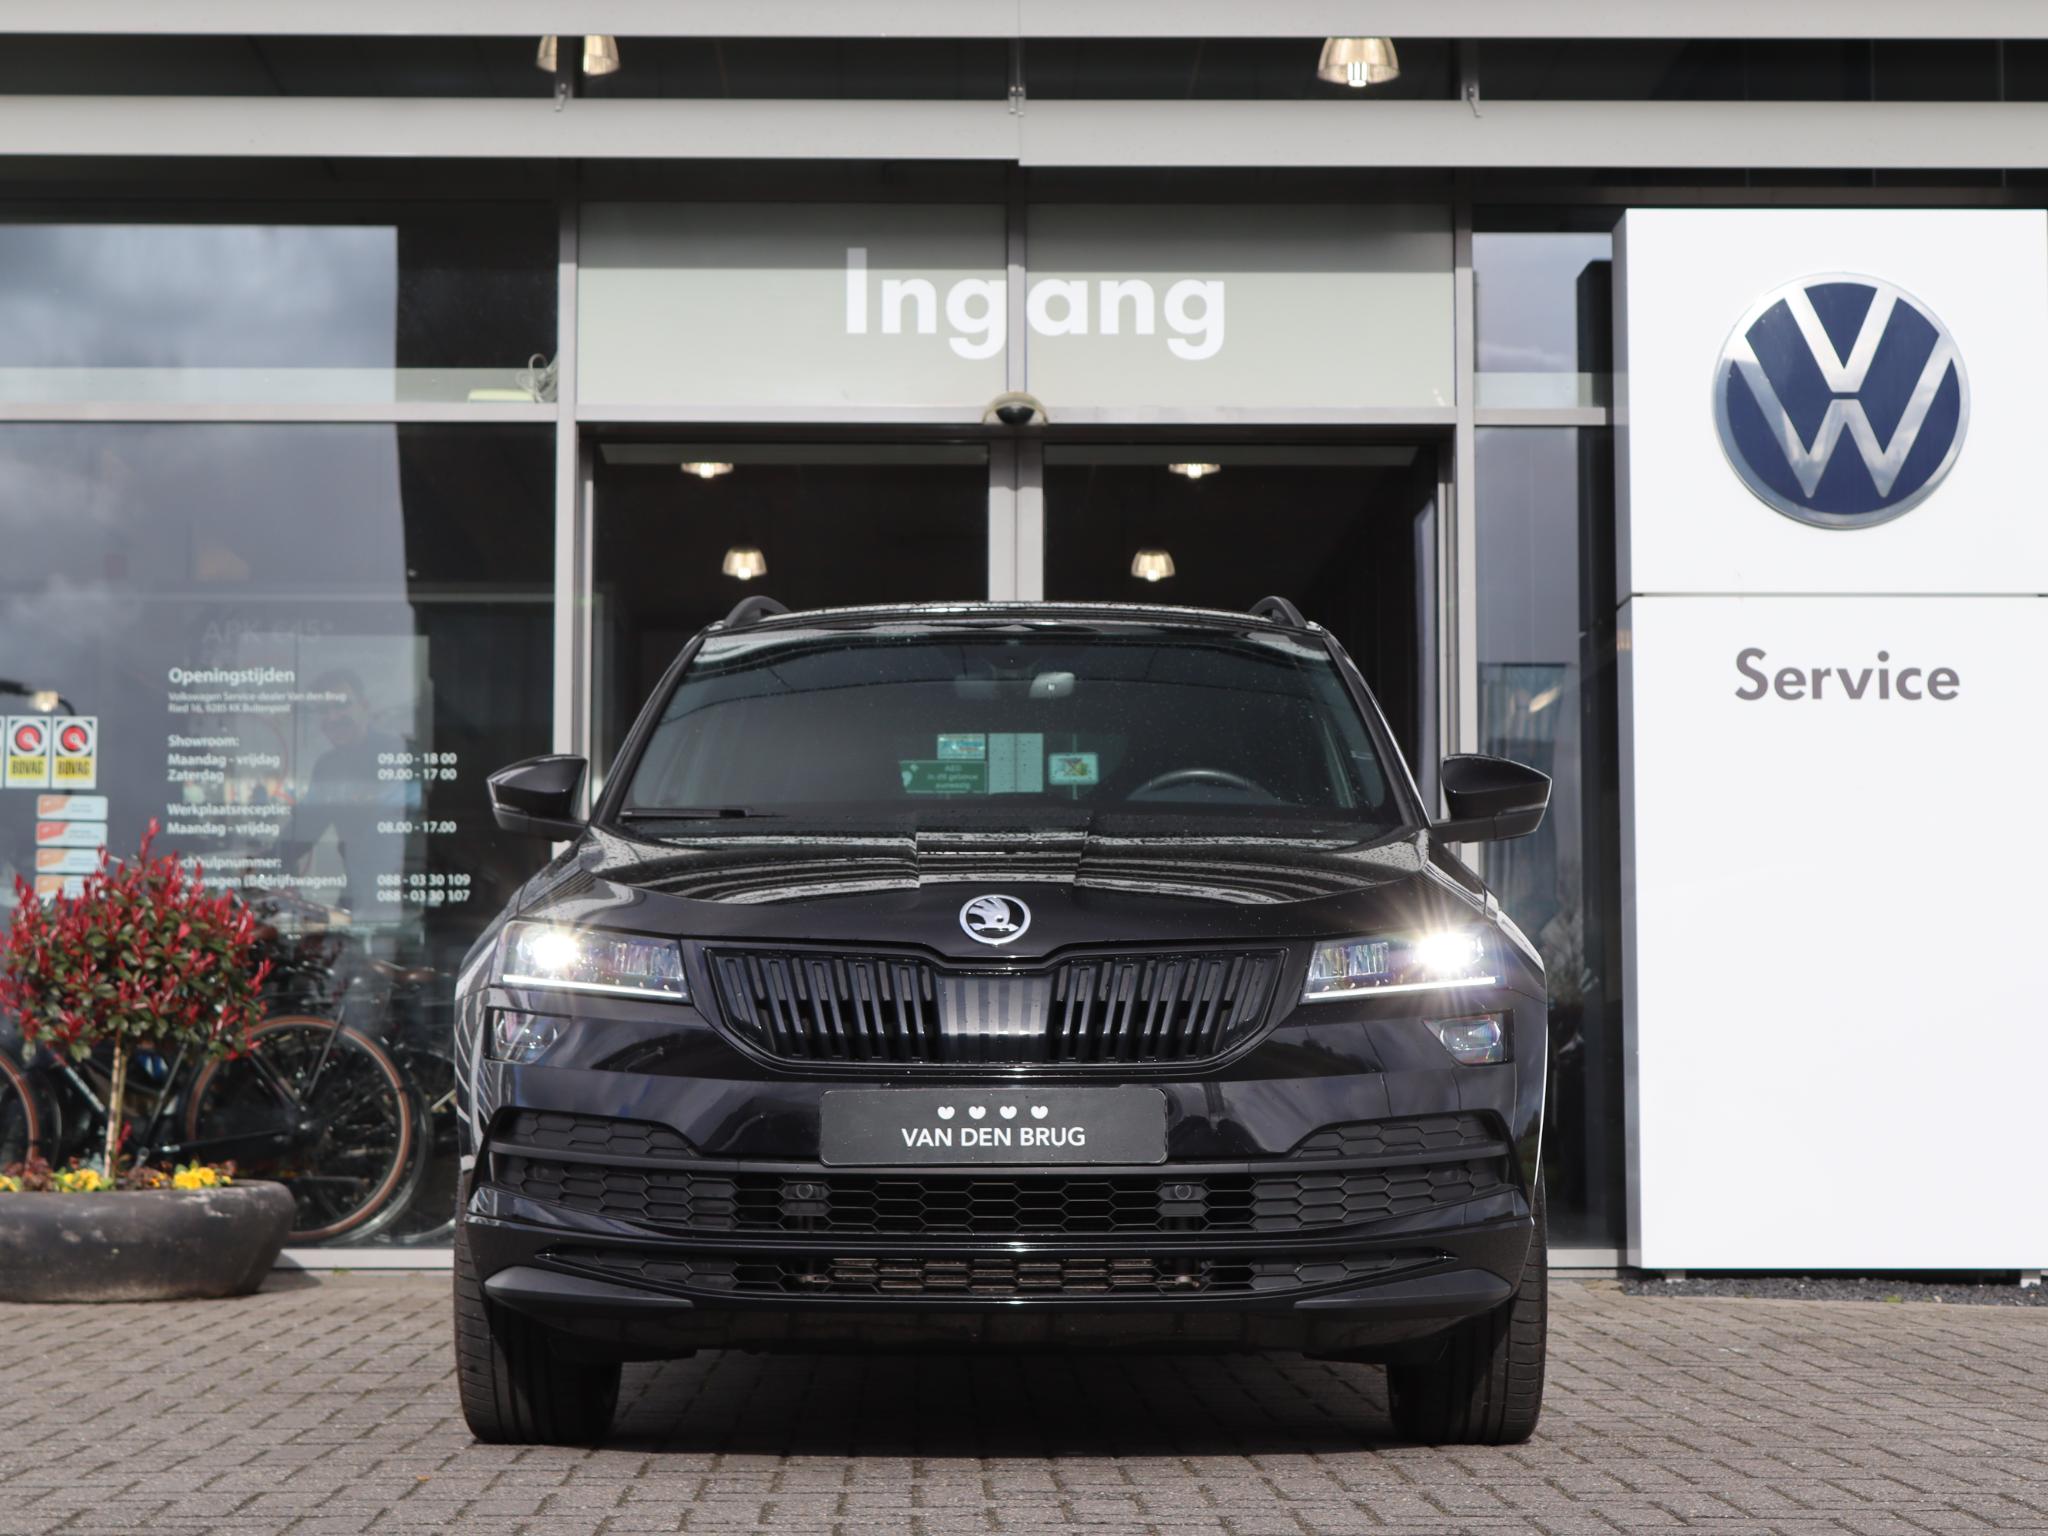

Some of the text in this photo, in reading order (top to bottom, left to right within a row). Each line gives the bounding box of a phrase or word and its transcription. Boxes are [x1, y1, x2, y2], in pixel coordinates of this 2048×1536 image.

[846, 247, 1225, 361] Ingang
[168, 667, 296, 686] Openingstijden
[1735, 647, 1960, 701] Service
[168, 735, 240, 747] Showroom:
[168, 753, 227, 768] Maandag
[236, 753, 280, 768] vrijdag
[377, 753, 413, 765] 09.00
[168, 769, 224, 784] Zaterdag
[377, 768, 413, 780] 09.00
[167, 822, 226, 837] Maandag
[235, 821, 279, 837] vrijdag
[423, 821, 457, 833] 17.00
[447, 874, 471, 886] 109
[447, 890, 470, 902] 107
[901, 1127, 1086, 1147] VAN DEN BRUG
